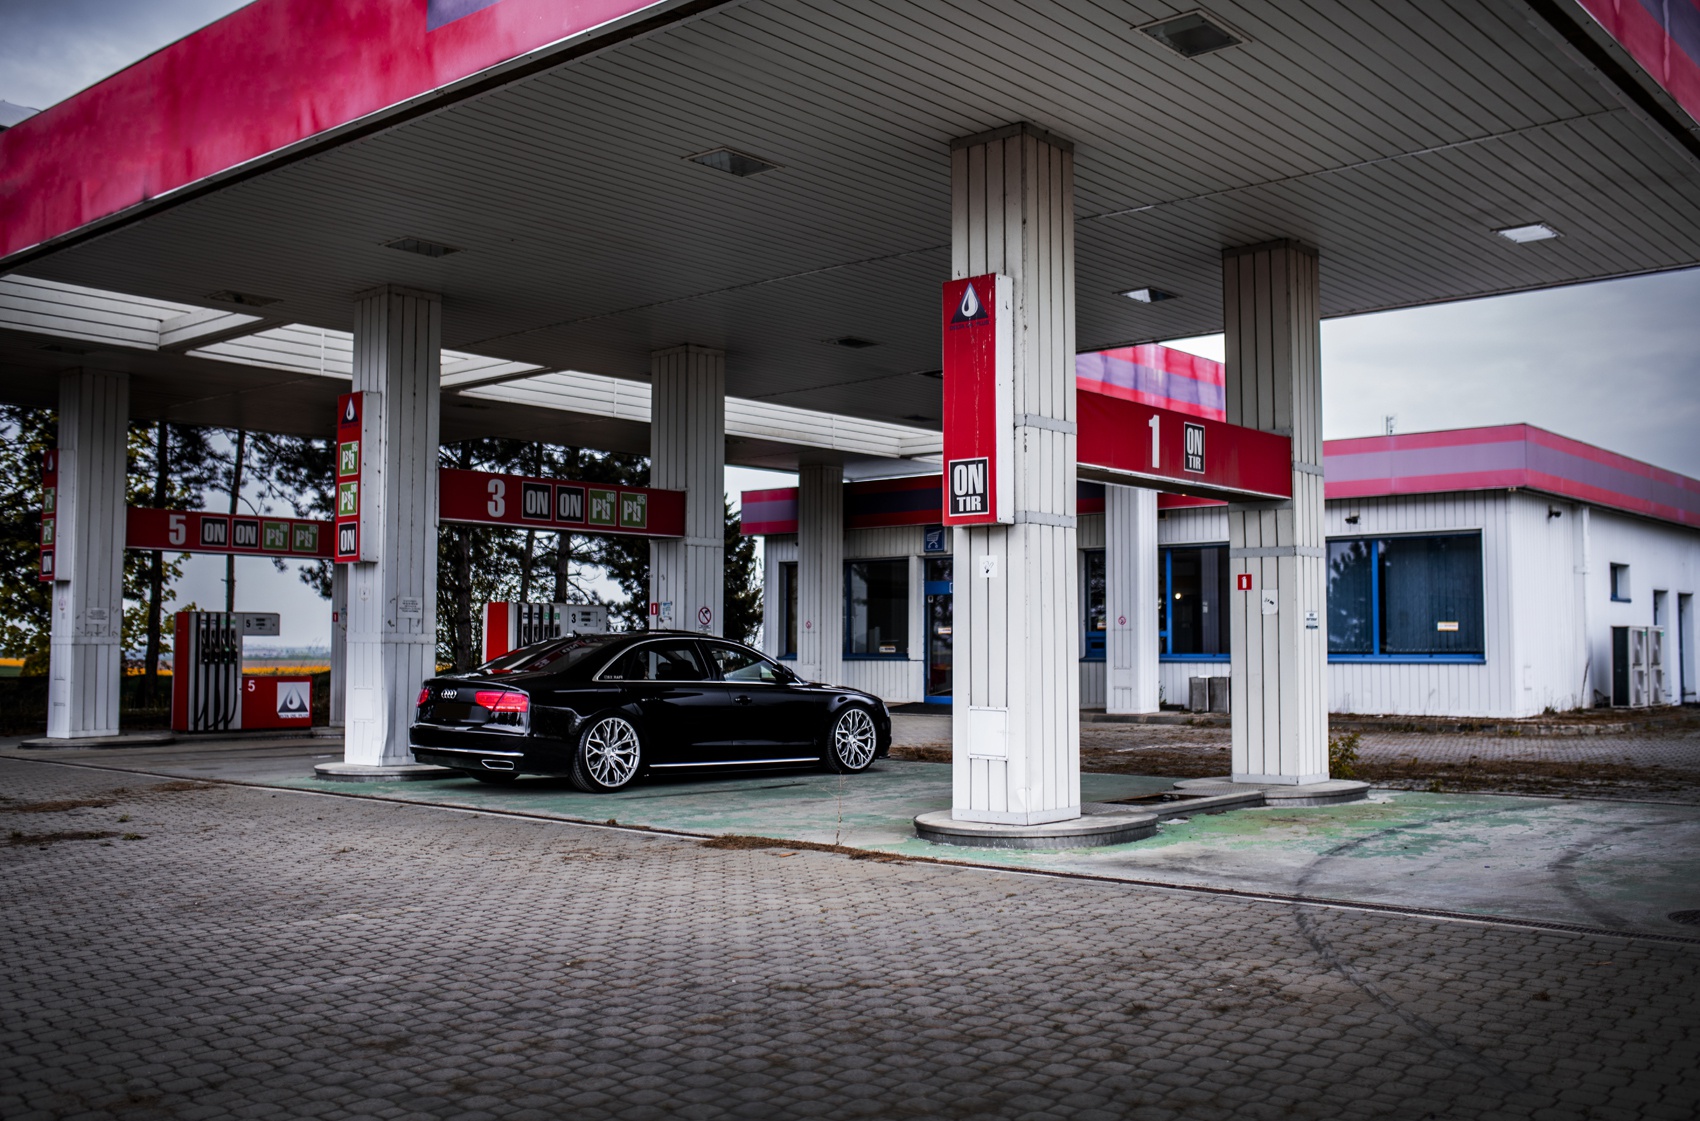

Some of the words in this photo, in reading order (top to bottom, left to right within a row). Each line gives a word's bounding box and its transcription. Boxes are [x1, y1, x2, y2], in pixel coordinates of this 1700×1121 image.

[1149, 414, 1159, 468] 1
[1187, 428, 1202, 455] ON
[342, 449, 354, 470] Pb
[1188, 455, 1201, 469] TIR
[954, 464, 984, 495] ON
[341, 491, 354, 511] Pb
[488, 479, 505, 517] 3
[526, 490, 548, 515] ON
[560, 494, 581, 517] ON
[592, 498, 610, 520] Pb
[624, 500, 641, 522] Pb
[956, 496, 981, 511] TIR
[169, 514, 186, 545] 5
[204, 523, 225, 542] ON
[236, 526, 256, 544] ON
[266, 528, 284, 546] Pb
[296, 529, 312, 548] Pb
[340, 529, 354, 551] ON
[572, 614, 576, 623] 3
[248, 680, 255, 692] 5
